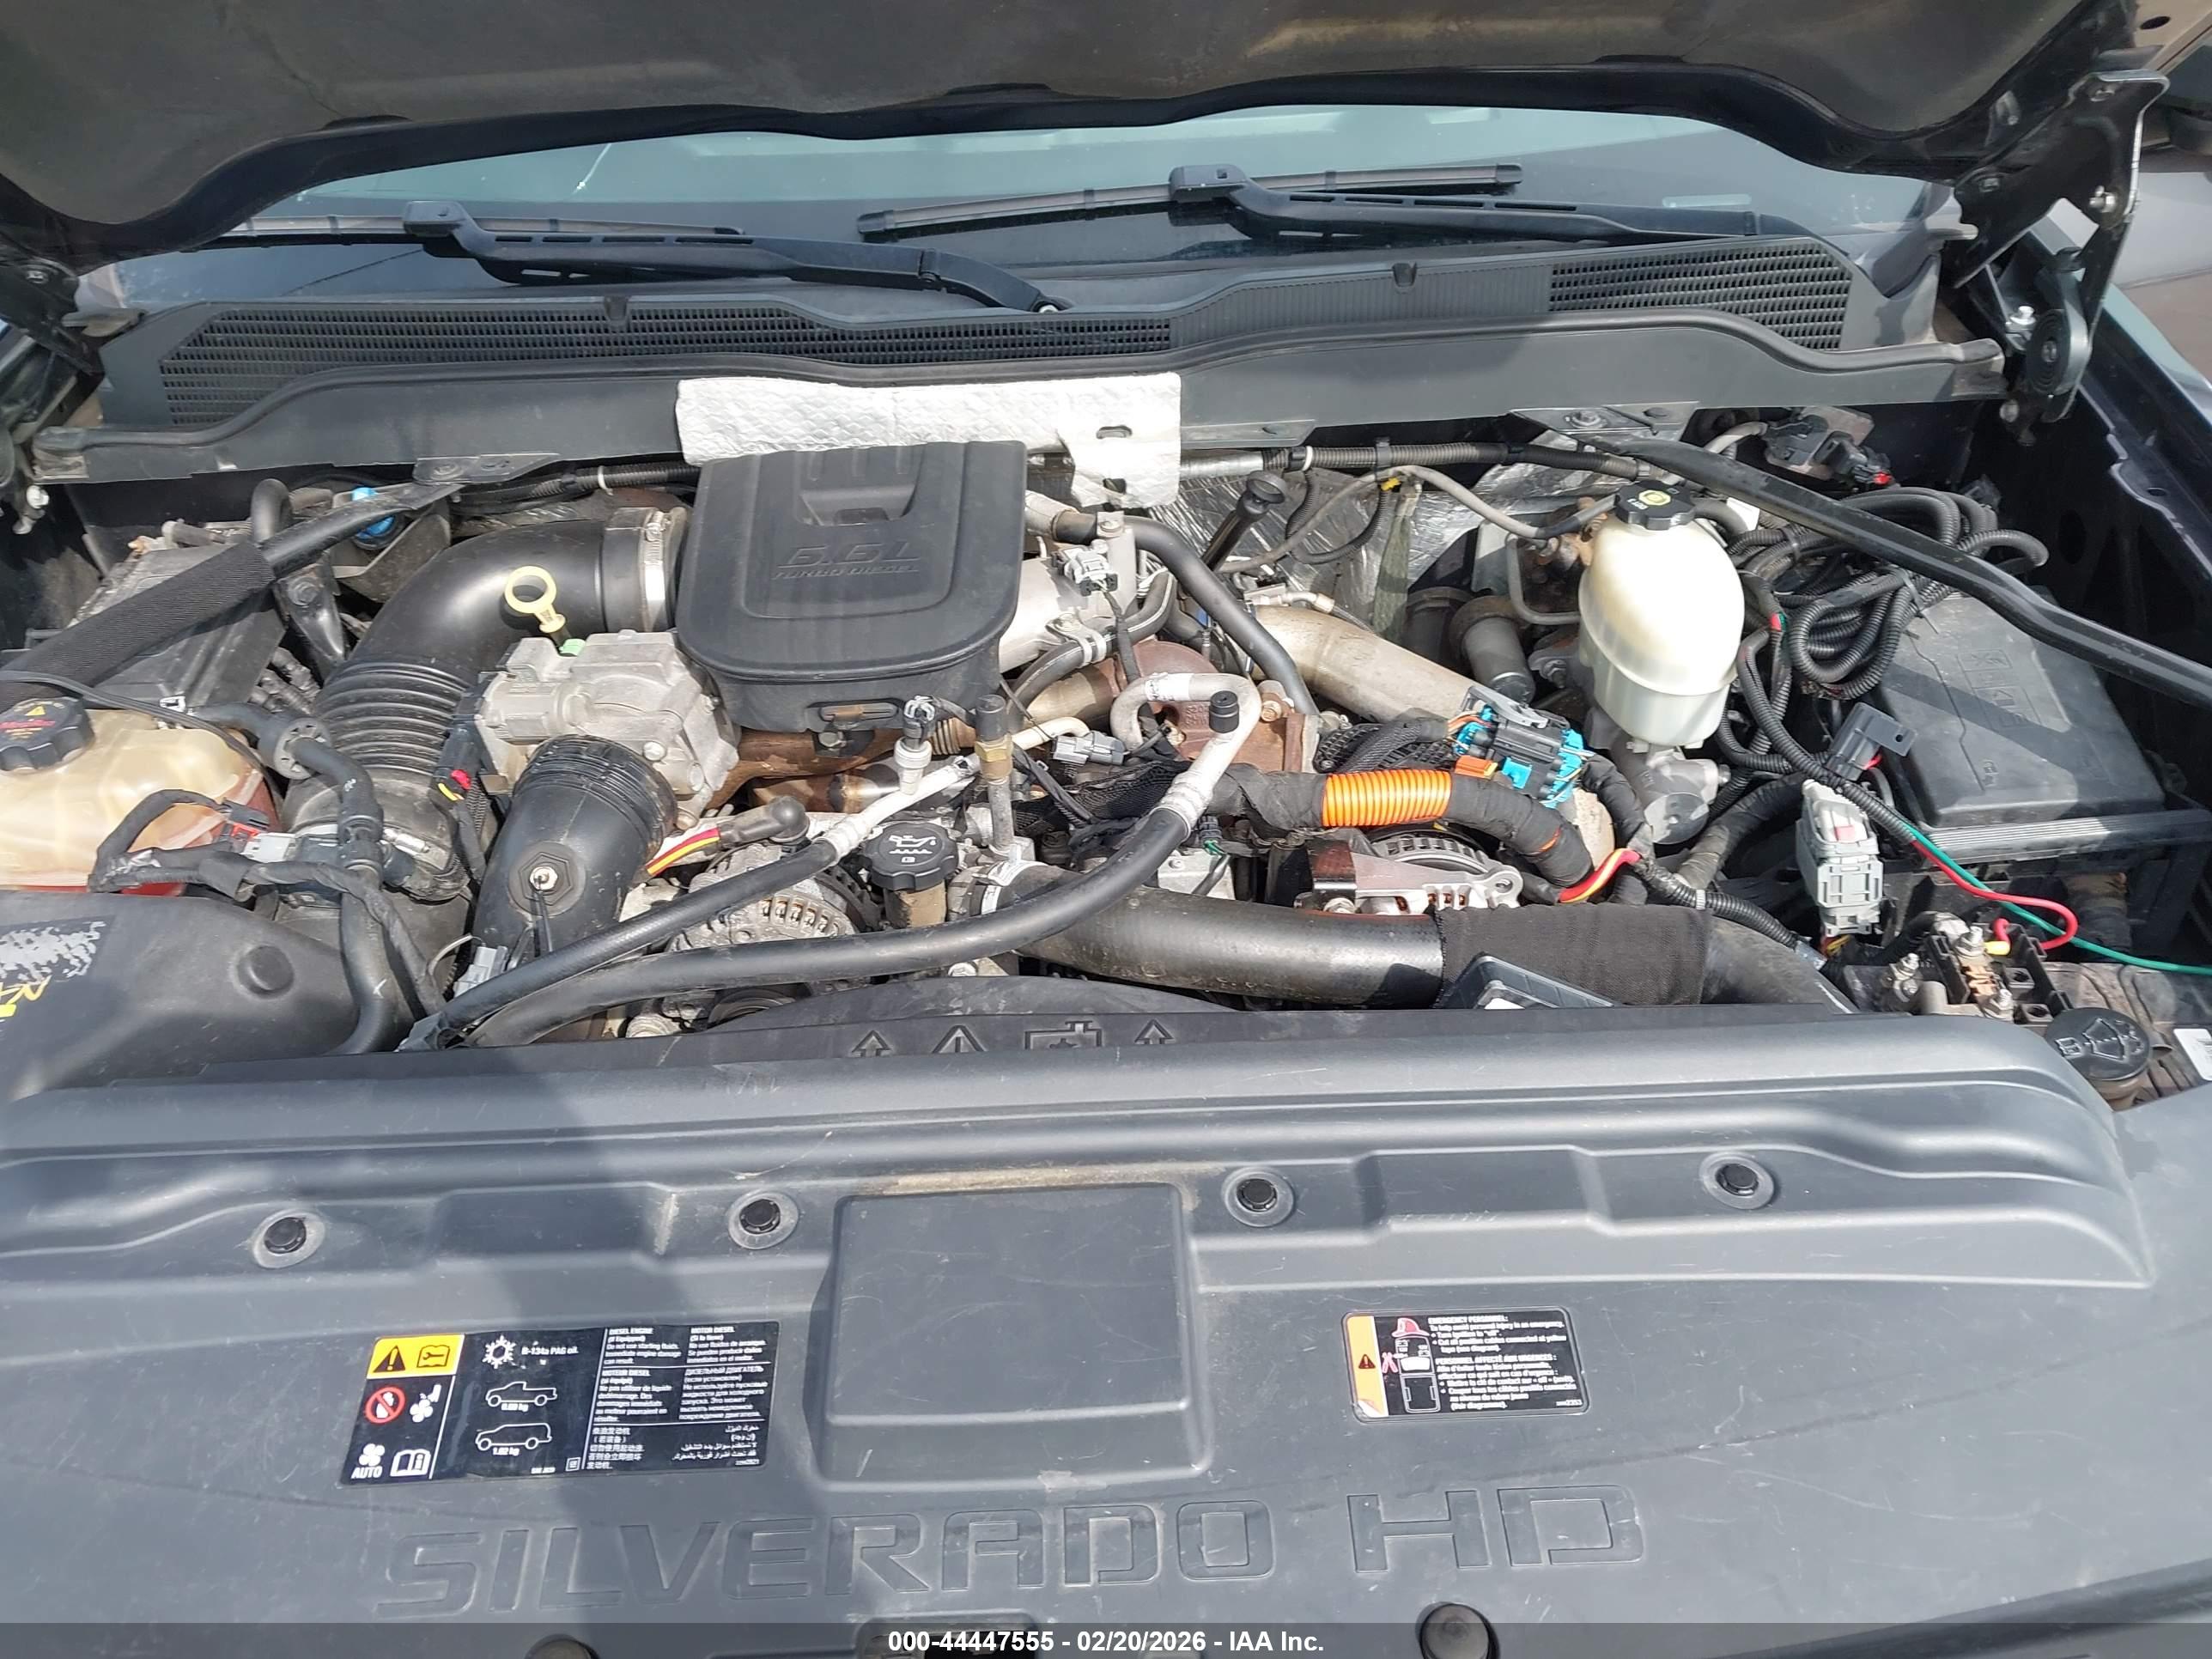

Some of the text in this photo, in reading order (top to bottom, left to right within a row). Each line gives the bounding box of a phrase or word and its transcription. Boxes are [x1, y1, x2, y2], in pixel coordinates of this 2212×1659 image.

[777, 542, 921, 568] 6.6L
[350, 1466, 383, 1479] AUTO
[372, 1485, 1645, 1620] SILVERADO HD
